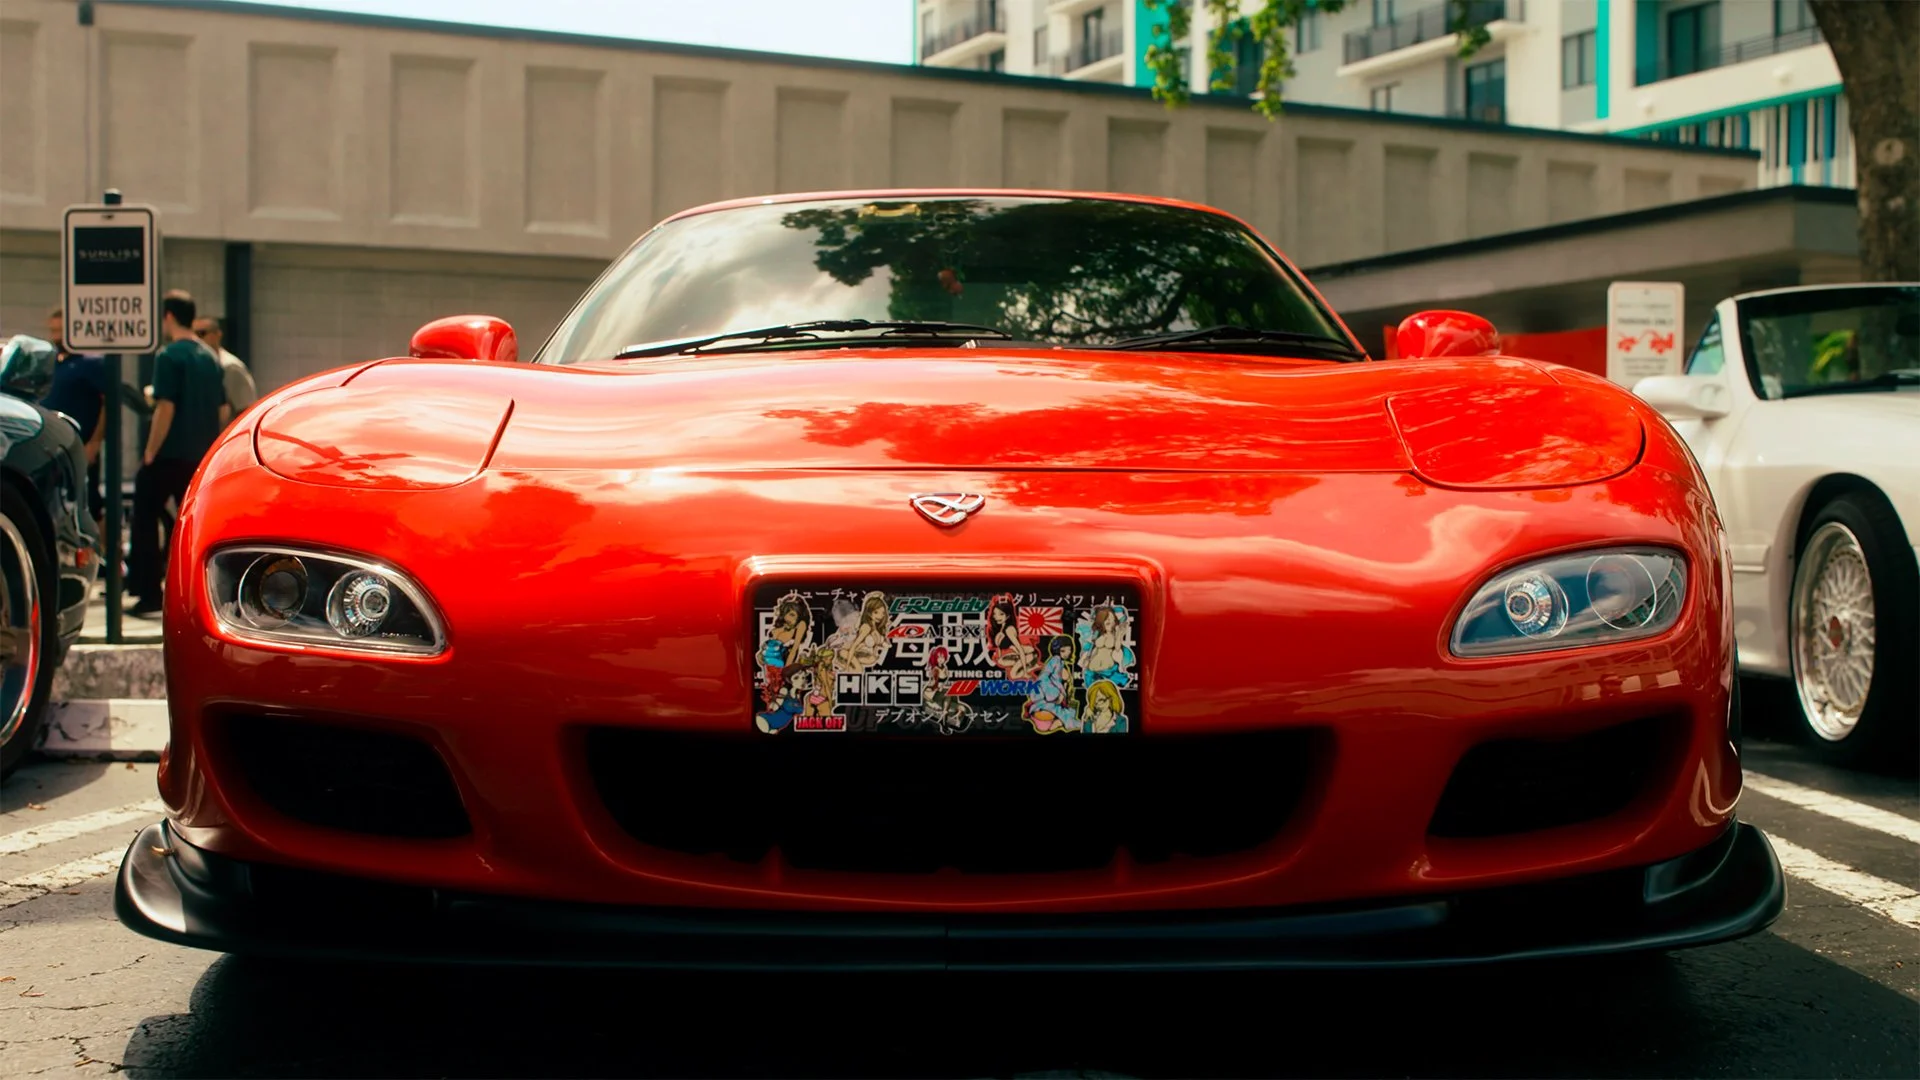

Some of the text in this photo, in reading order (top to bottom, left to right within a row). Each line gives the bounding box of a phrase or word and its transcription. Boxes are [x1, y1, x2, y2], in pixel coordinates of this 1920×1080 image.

[78, 296, 142, 315] VISITOR
[73, 319, 147, 338] PARKING
[839, 675, 920, 695] HKS
[980, 680, 1041, 696] WORK
[797, 716, 844, 729] JACK OFF
